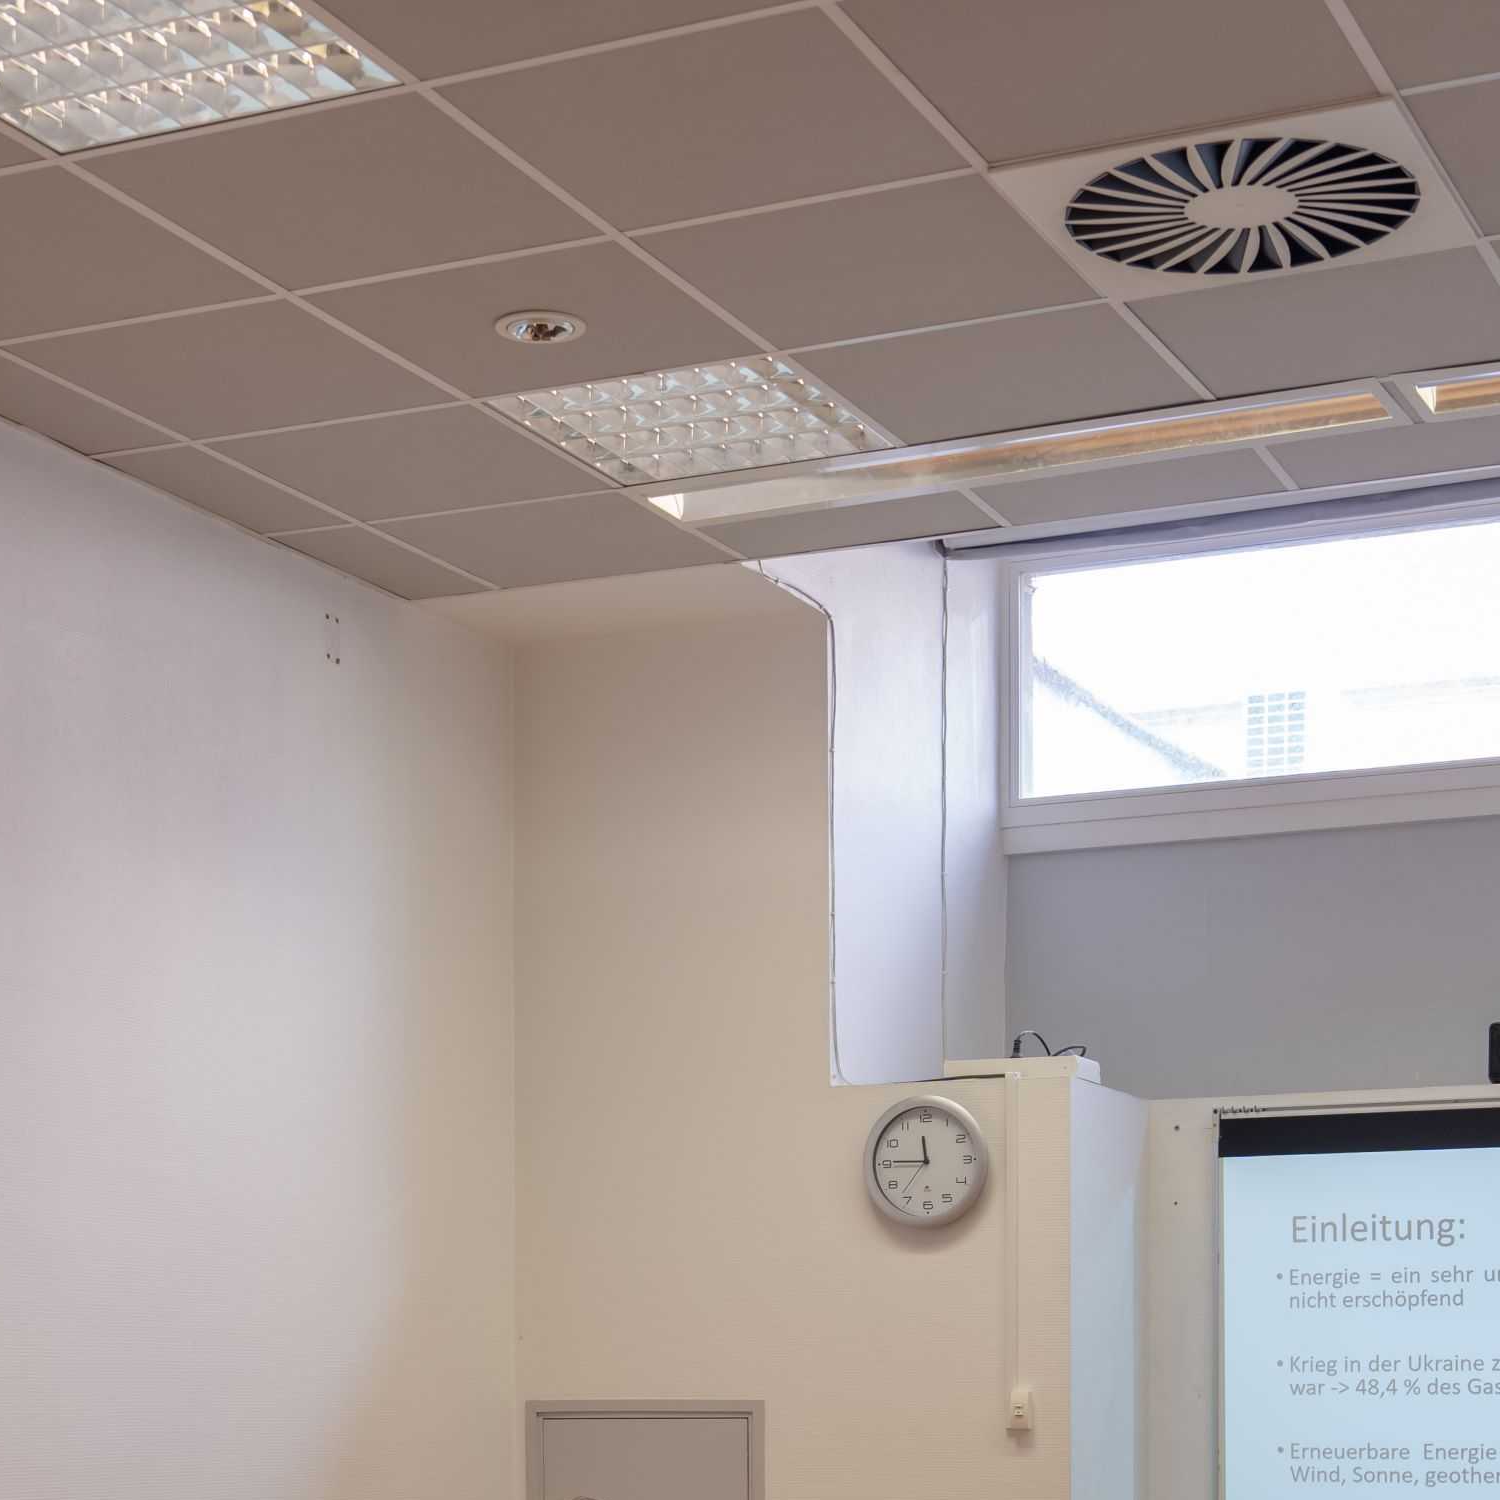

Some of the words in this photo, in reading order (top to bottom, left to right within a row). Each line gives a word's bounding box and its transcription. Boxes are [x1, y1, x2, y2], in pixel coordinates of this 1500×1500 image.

[919, 1113, 933, 1123] 12
[901, 1121, 909, 1131] 11
[956, 1134, 966, 1143] 2
[886, 1139, 899, 1148] 10
[963, 1155, 973, 1164] 3
[882, 1160, 892, 1169] 9
[888, 1180, 898, 1189] 8
[956, 1176, 967, 1185] 4
[902, 1196, 912, 1205] 7
[942, 1194, 953, 1203] 5
[923, 1201, 934, 1210] 6
[1292, 1213, 1466, 1248] Einleitung:
[1289, 1267, 1361, 1289] Energie
[1390, 1266, 1421, 1284] ein
[1430, 1264, 1475, 1284] sehr
[1289, 1290, 1337, 1310] nicht
[1342, 1287, 1465, 1313] erschöpfend
[1289, 1355, 1338, 1377] Krieg
[1344, 1355, 1361, 1373] in
[1367, 1353, 1402, 1374] der
[1408, 1352, 1485, 1373] Ukraine
[1289, 1383, 1326, 1396] war
[1355, 1378, 1399, 1400] 48,4
[1403, 1377, 1421, 1397] %
[1427, 1376, 1461, 1396] des
[1290, 1441, 1411, 1461] Erneuerbare
[1423, 1442, 1498, 1465] Energie
[1289, 1464, 1346, 1487] Wind,
[1352, 1465, 1419, 1487] Sonne,
